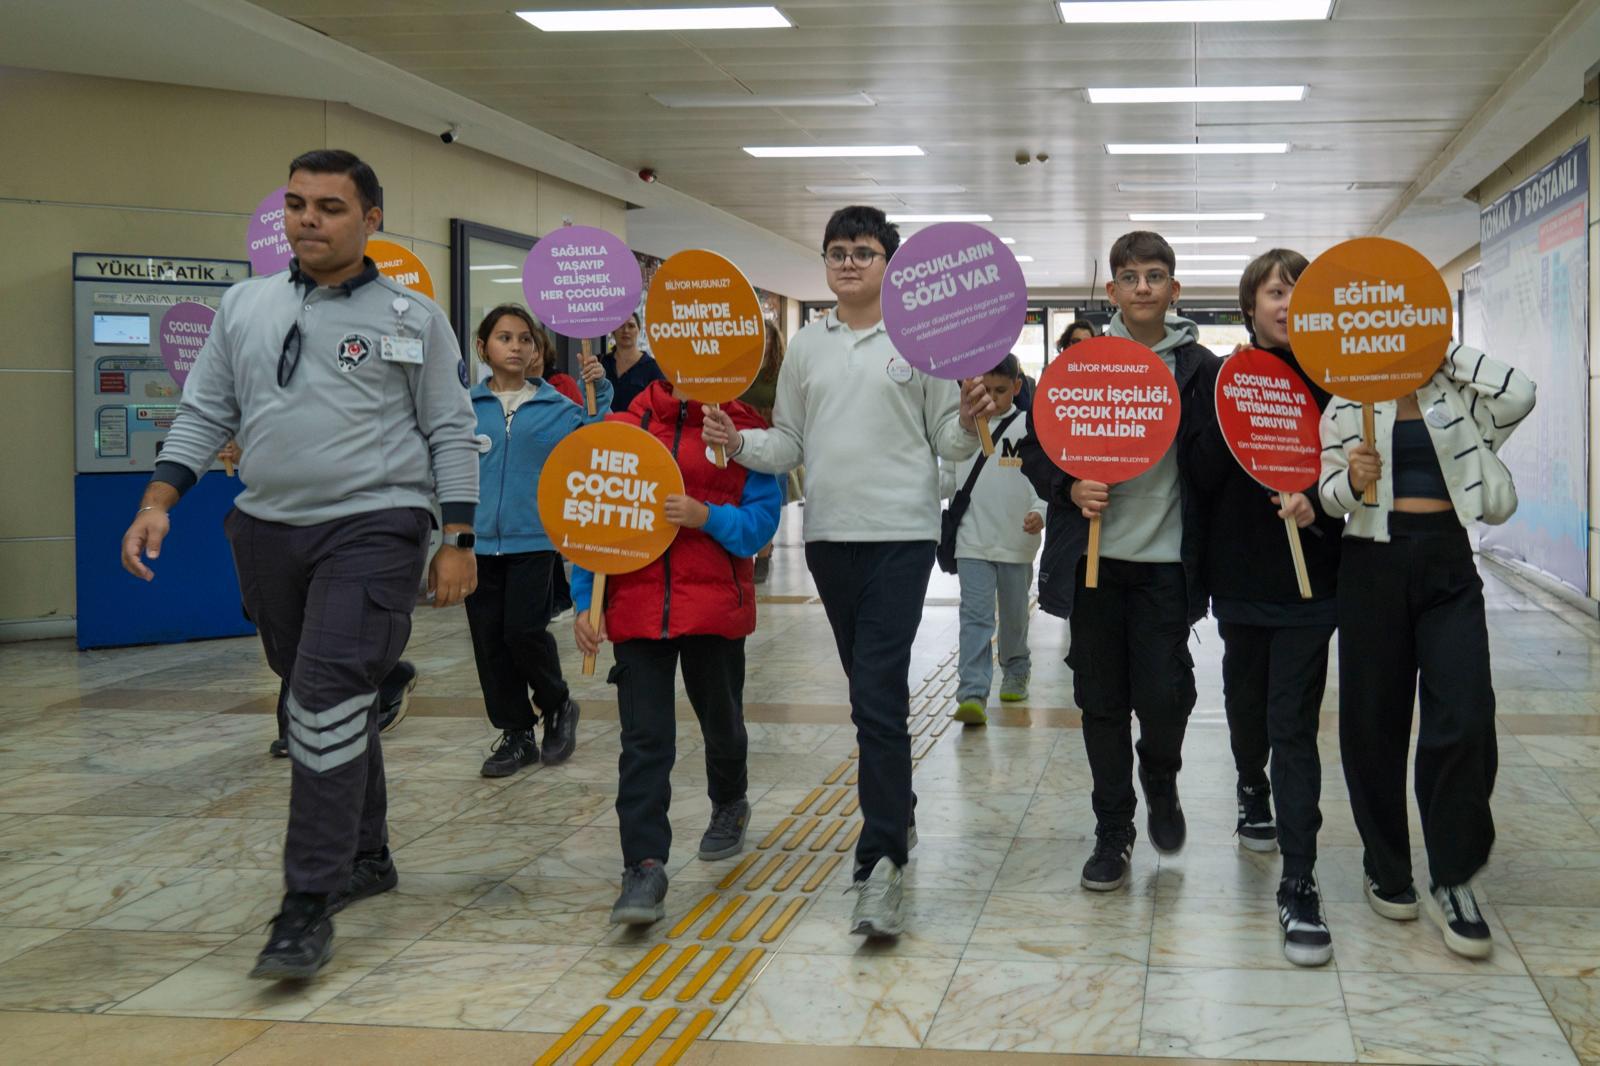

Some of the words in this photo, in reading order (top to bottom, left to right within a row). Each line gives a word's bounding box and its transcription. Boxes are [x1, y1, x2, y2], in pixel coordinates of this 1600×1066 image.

[1481, 200, 1511, 242] KONAK
[1525, 154, 1578, 217] BOSTANLI
[251, 234, 279, 250] OYUN
[551, 244, 608, 257] SAĞLIKLA
[96, 260, 215, 280] YÜKLEMATİK
[556, 260, 605, 273] YAŞAYIP
[890, 241, 995, 289] ÇOCUKLARIN
[553, 273, 610, 286] GELİŞMEK
[665, 280, 691, 290] BİLİYOR
[691, 278, 731, 289] MUSUNUZ?
[902, 273, 957, 311] SÖZÜ
[958, 264, 1001, 291] VAR
[540, 290, 564, 300] HER
[565, 285, 625, 301] ÇOCUĞUN
[1333, 280, 1405, 306] EĞİTİM
[567, 302, 604, 313] HAKKI
[168, 320, 210, 334] ÇOCUKL
[650, 321, 700, 342] ÇOCUK
[702, 314, 759, 337] MECLİSİ
[1293, 313, 1335, 333] HER
[1337, 304, 1448, 334] ÇOCUĞUN
[163, 334, 203, 346] YARININ
[691, 339, 720, 355] VAR
[1340, 334, 1406, 355] HAKKI
[1067, 362, 1100, 372] BİLİYOR
[1101, 364, 1150, 374] MUSUNUZ?
[1233, 373, 1291, 390] ÇOCUKLARI
[1047, 387, 1104, 403] ÇOCUK
[1107, 385, 1173, 406] İŞÇİLİĞİ,
[1223, 383, 1262, 400] ŞİDDET,
[1262, 387, 1293, 403] İHMAL
[1293, 393, 1307, 405] VE
[1055, 405, 1112, 421] ÇOCUK
[1115, 407, 1163, 421] HAKKI
[1236, 398, 1303, 418] İSTİSMARDAN
[1071, 419, 1146, 438] İHLALİDİR
[1250, 415, 1298, 430] KORUYUN
[1001, 438, 1023, 458] M
[590, 448, 639, 475] HER
[566, 471, 659, 504] ÇOCUK
[563, 496, 655, 532] EŞİTTİR
